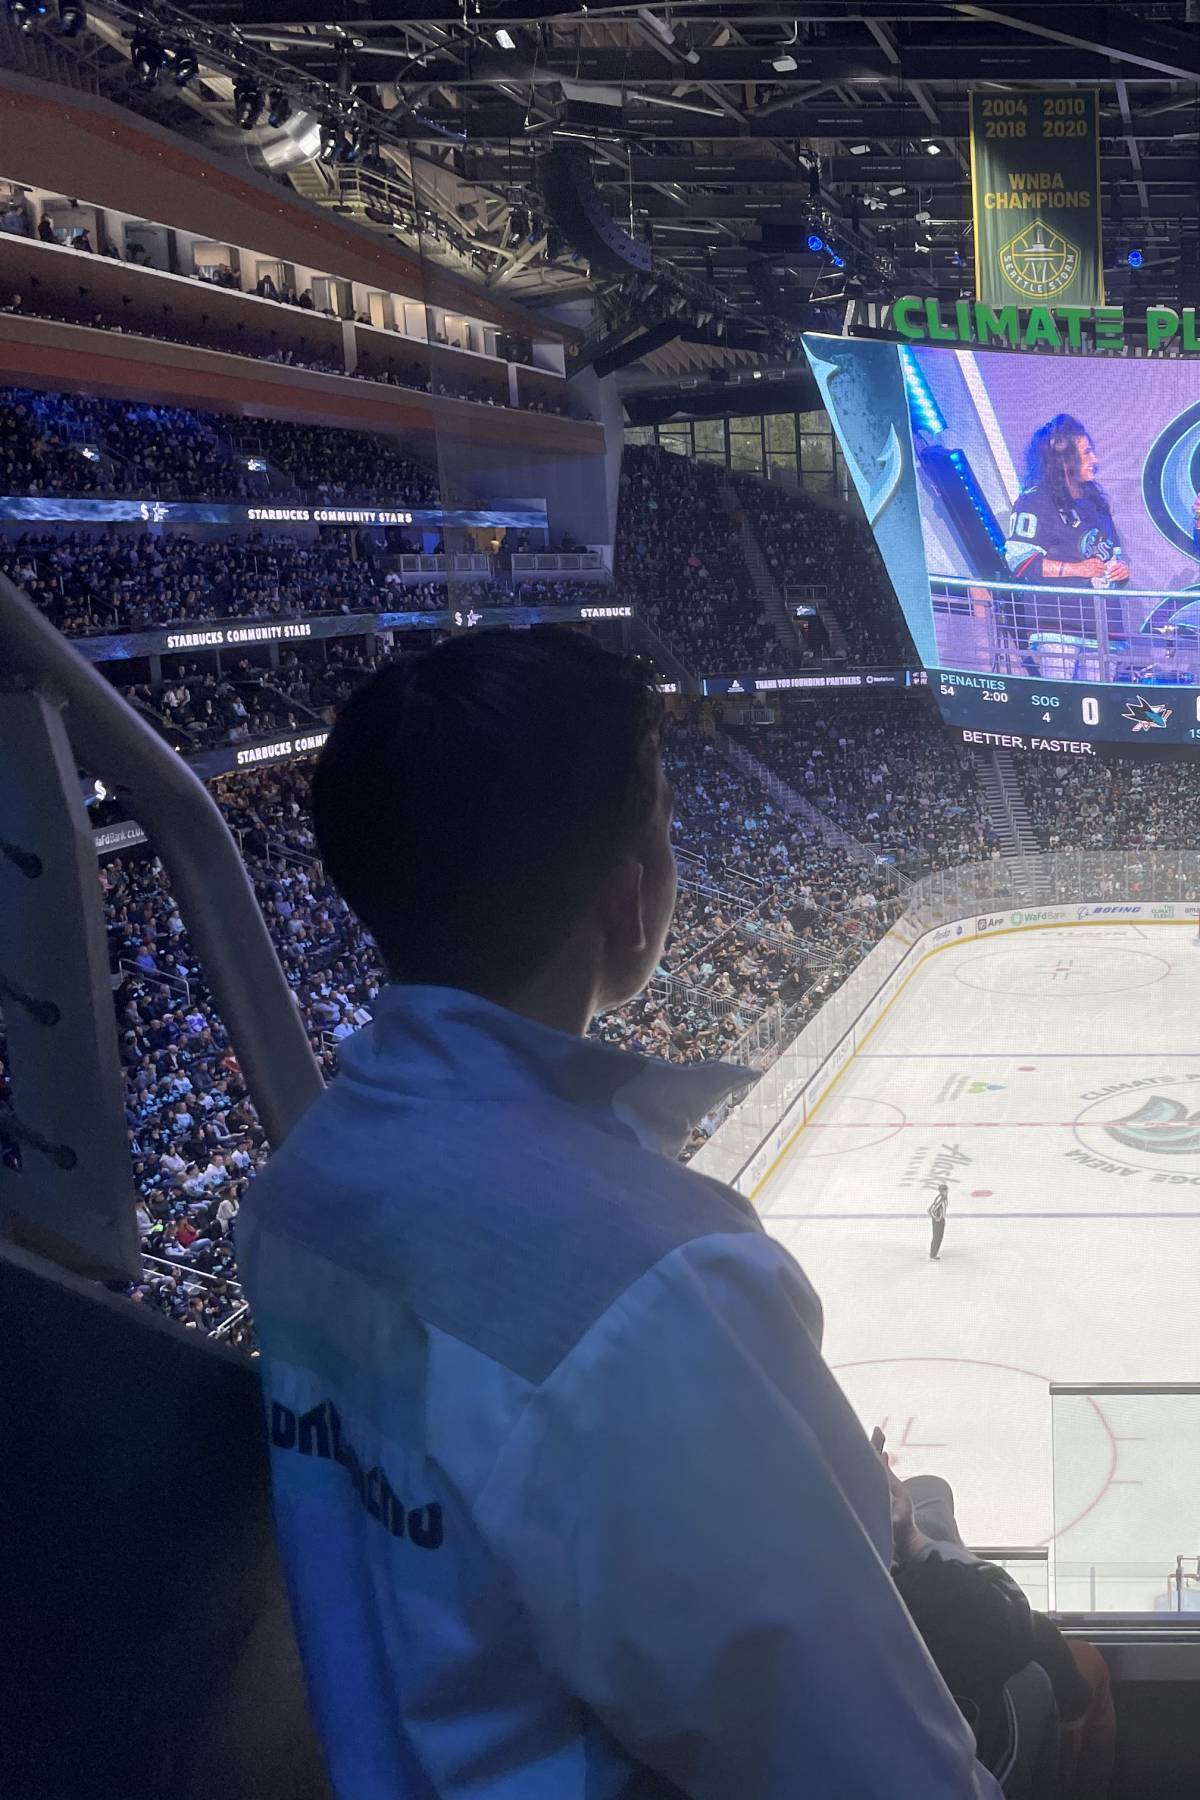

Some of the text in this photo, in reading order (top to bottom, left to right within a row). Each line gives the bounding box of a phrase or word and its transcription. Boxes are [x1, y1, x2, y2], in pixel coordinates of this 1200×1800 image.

[982, 98, 1085, 117] 2004 2010
[985, 120, 1088, 138] 2018 2020
[1008, 173, 1064, 190] WNBA
[984, 191, 1090, 209] CHAMPIONS
[1003, 254, 1075, 293] SEATTLE STORM
[892, 295, 1124, 350] CLIMATE
[248, 509, 412, 523] STARBUCKS COMMUNITY STARS
[167, 624, 311, 648] STARBUCKS COMMUNITY STARS
[940, 674, 1005, 690] PENALTIES
[940, 685, 955, 696] 54
[982, 691, 1008, 702] 2:00
[1031, 695, 1060, 707] SOG
[1042, 712, 1051, 723] 4
[1082, 697, 1099, 726] 0
[962, 730, 1096, 755] BETTER, FASTER,
[237, 741, 292, 764] STARBUCKS
[1093, 906, 1141, 914] BOEING
[1080, 1074, 1175, 1101] CLIMATE
[1065, 1149, 1141, 1177] ARENA
